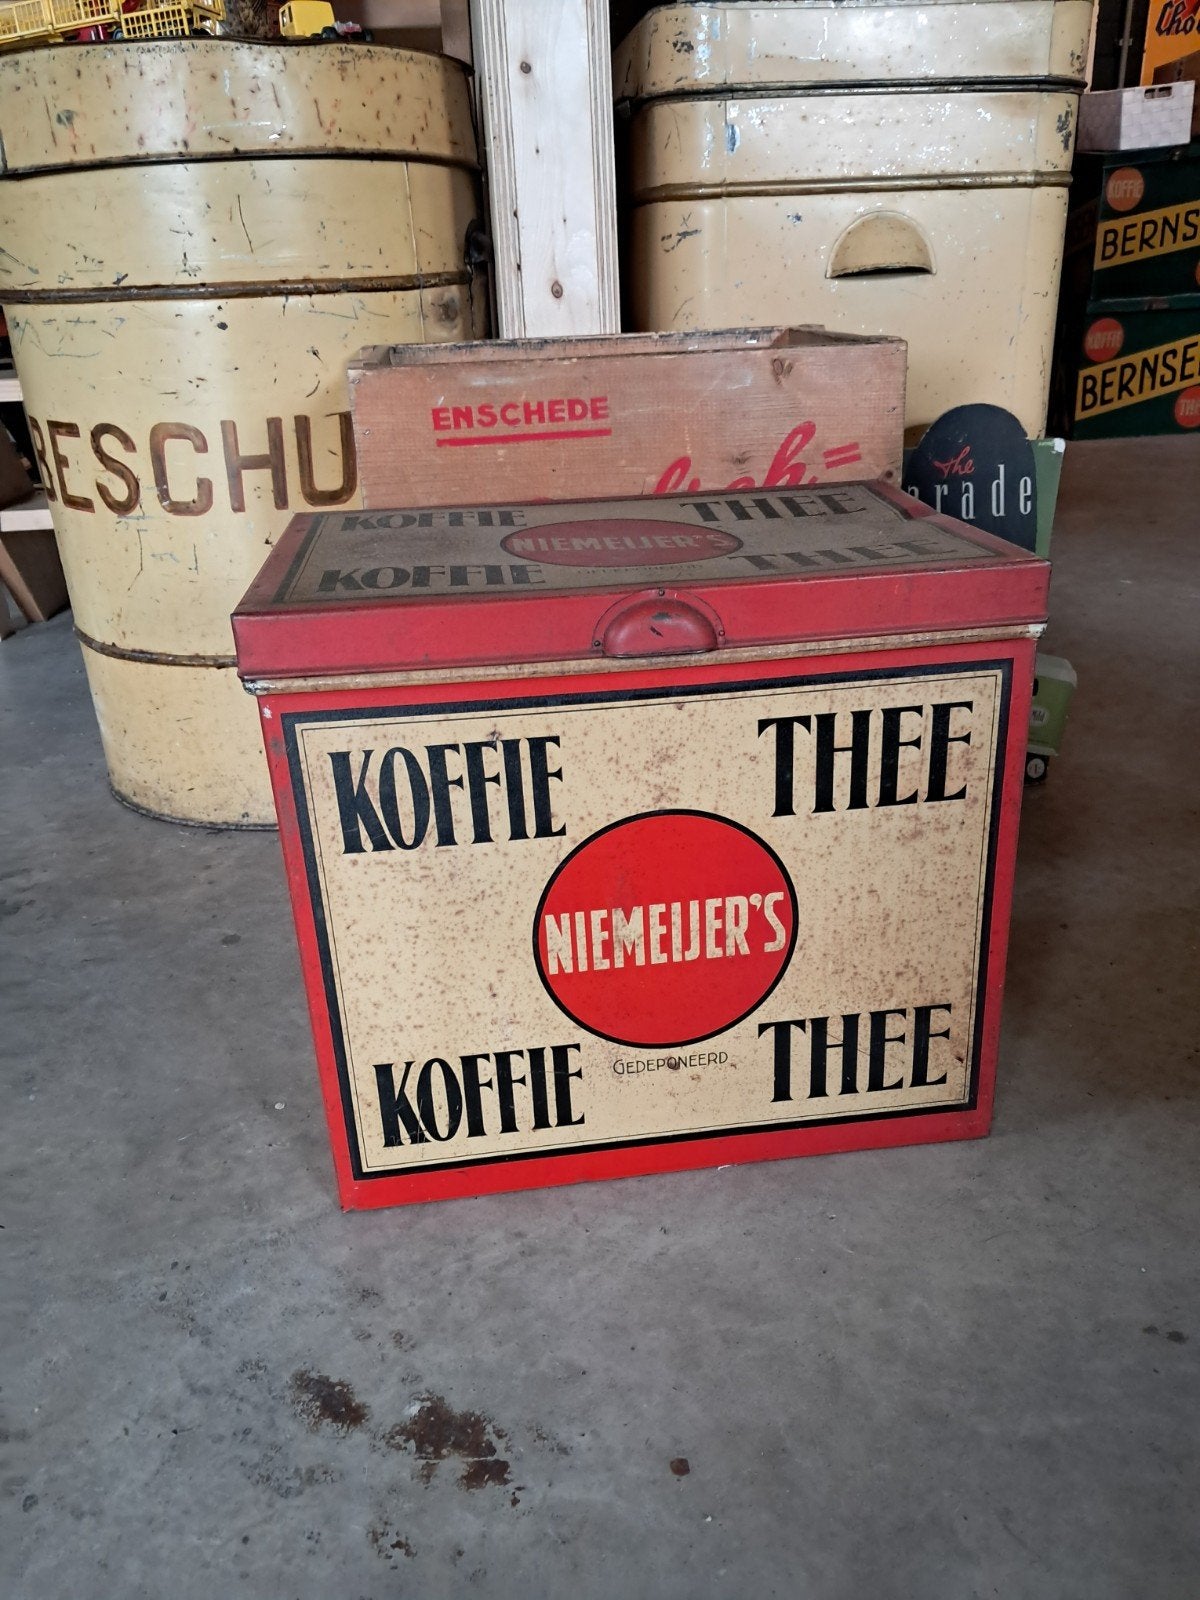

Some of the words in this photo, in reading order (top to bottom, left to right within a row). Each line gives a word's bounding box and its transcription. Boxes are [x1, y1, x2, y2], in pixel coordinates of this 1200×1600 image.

[1156, 0, 1200, 37] Cho
[1101, 208, 1200, 262] BERNS
[1081, 341, 1200, 413] BERNSE
[431, 396, 610, 432] ENSCHEDE
[341, 510, 527, 531] KOFFIE
[680, 492, 866, 522] THEE
[316, 564, 546, 593] KOFFIE
[728, 538, 958, 571] THEE
[327, 735, 566, 855] KOFFIE
[757, 701, 974, 818] THEE
[544, 891, 787, 976] NIEMEIJER'S
[372, 1042, 585, 1148] KOFFIE
[612, 1050, 729, 1075] GEDEPONEERD
[757, 1003, 952, 1103] THEE
